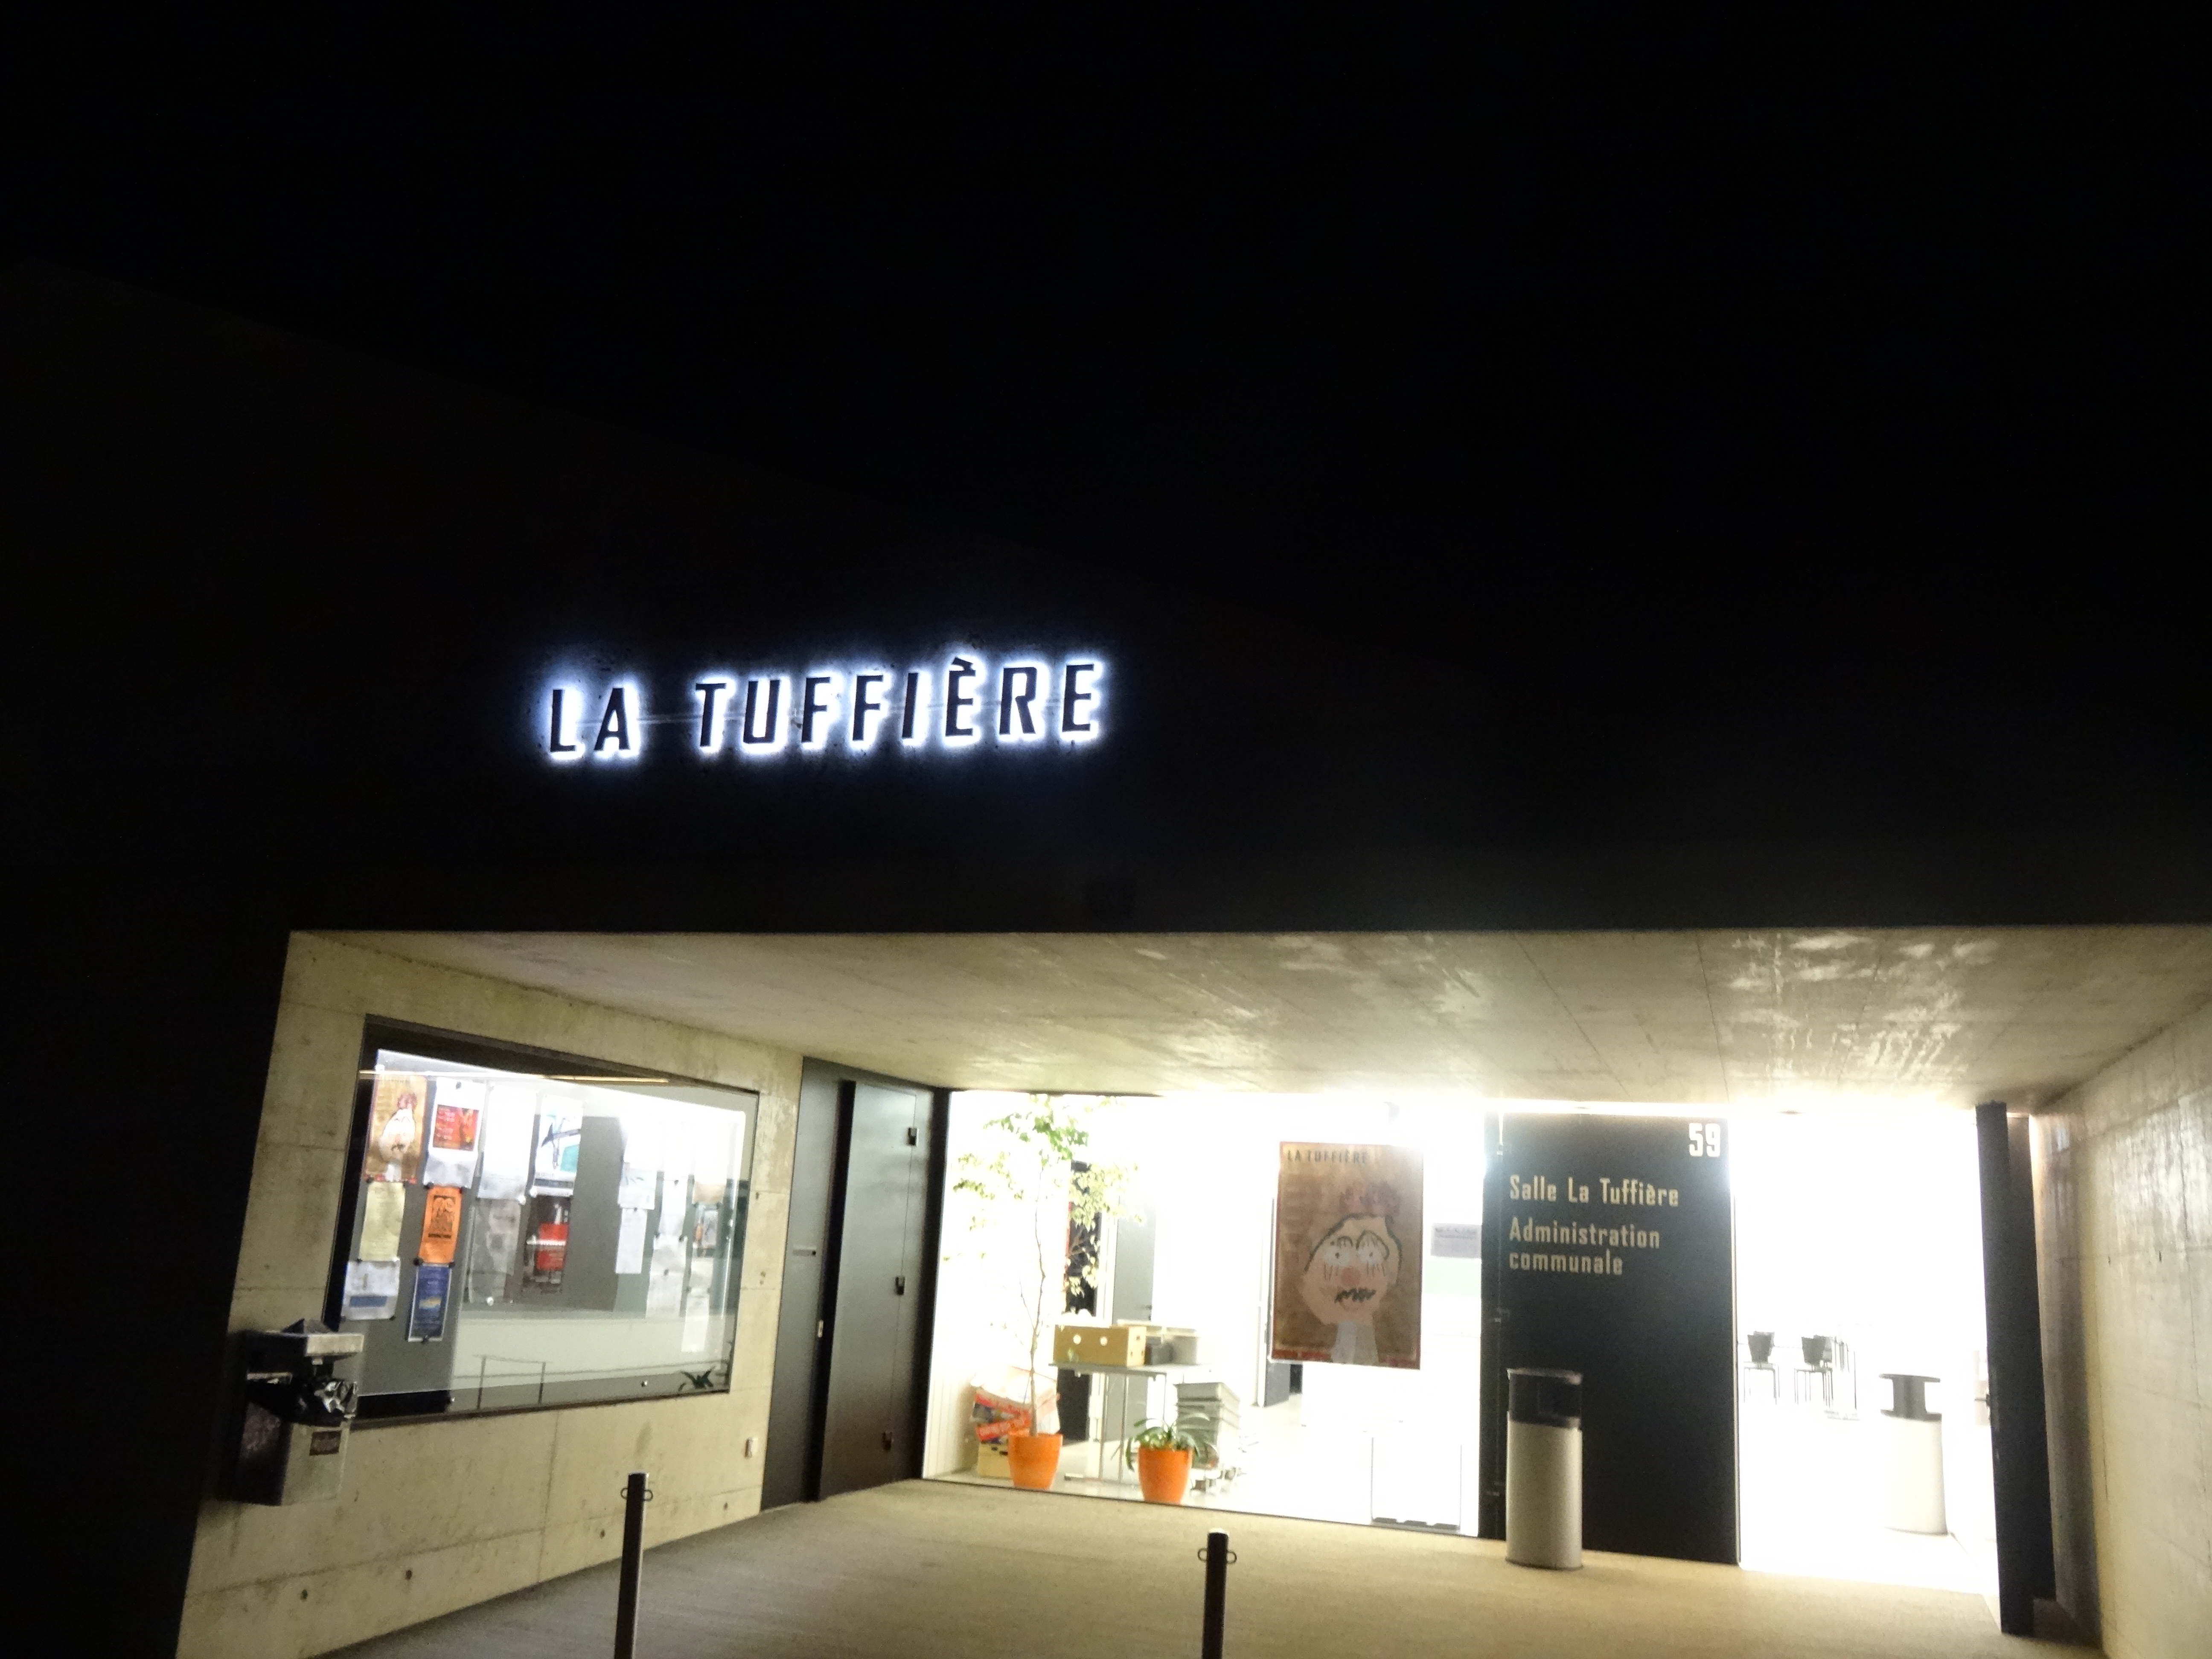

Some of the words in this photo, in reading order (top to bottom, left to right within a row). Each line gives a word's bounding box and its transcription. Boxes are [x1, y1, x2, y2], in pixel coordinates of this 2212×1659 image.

[550, 687, 631, 753] LA
[696, 657, 1095, 747] TUFFIÈRE
[1688, 1123, 1721, 1157] 59
[1510, 1174, 1557, 1201] Salle
[1568, 1176, 1589, 1203] La
[1599, 1177, 1679, 1207] Tuffière
[1509, 1217, 1660, 1249] Administration
[1509, 1250, 1624, 1275] communale
